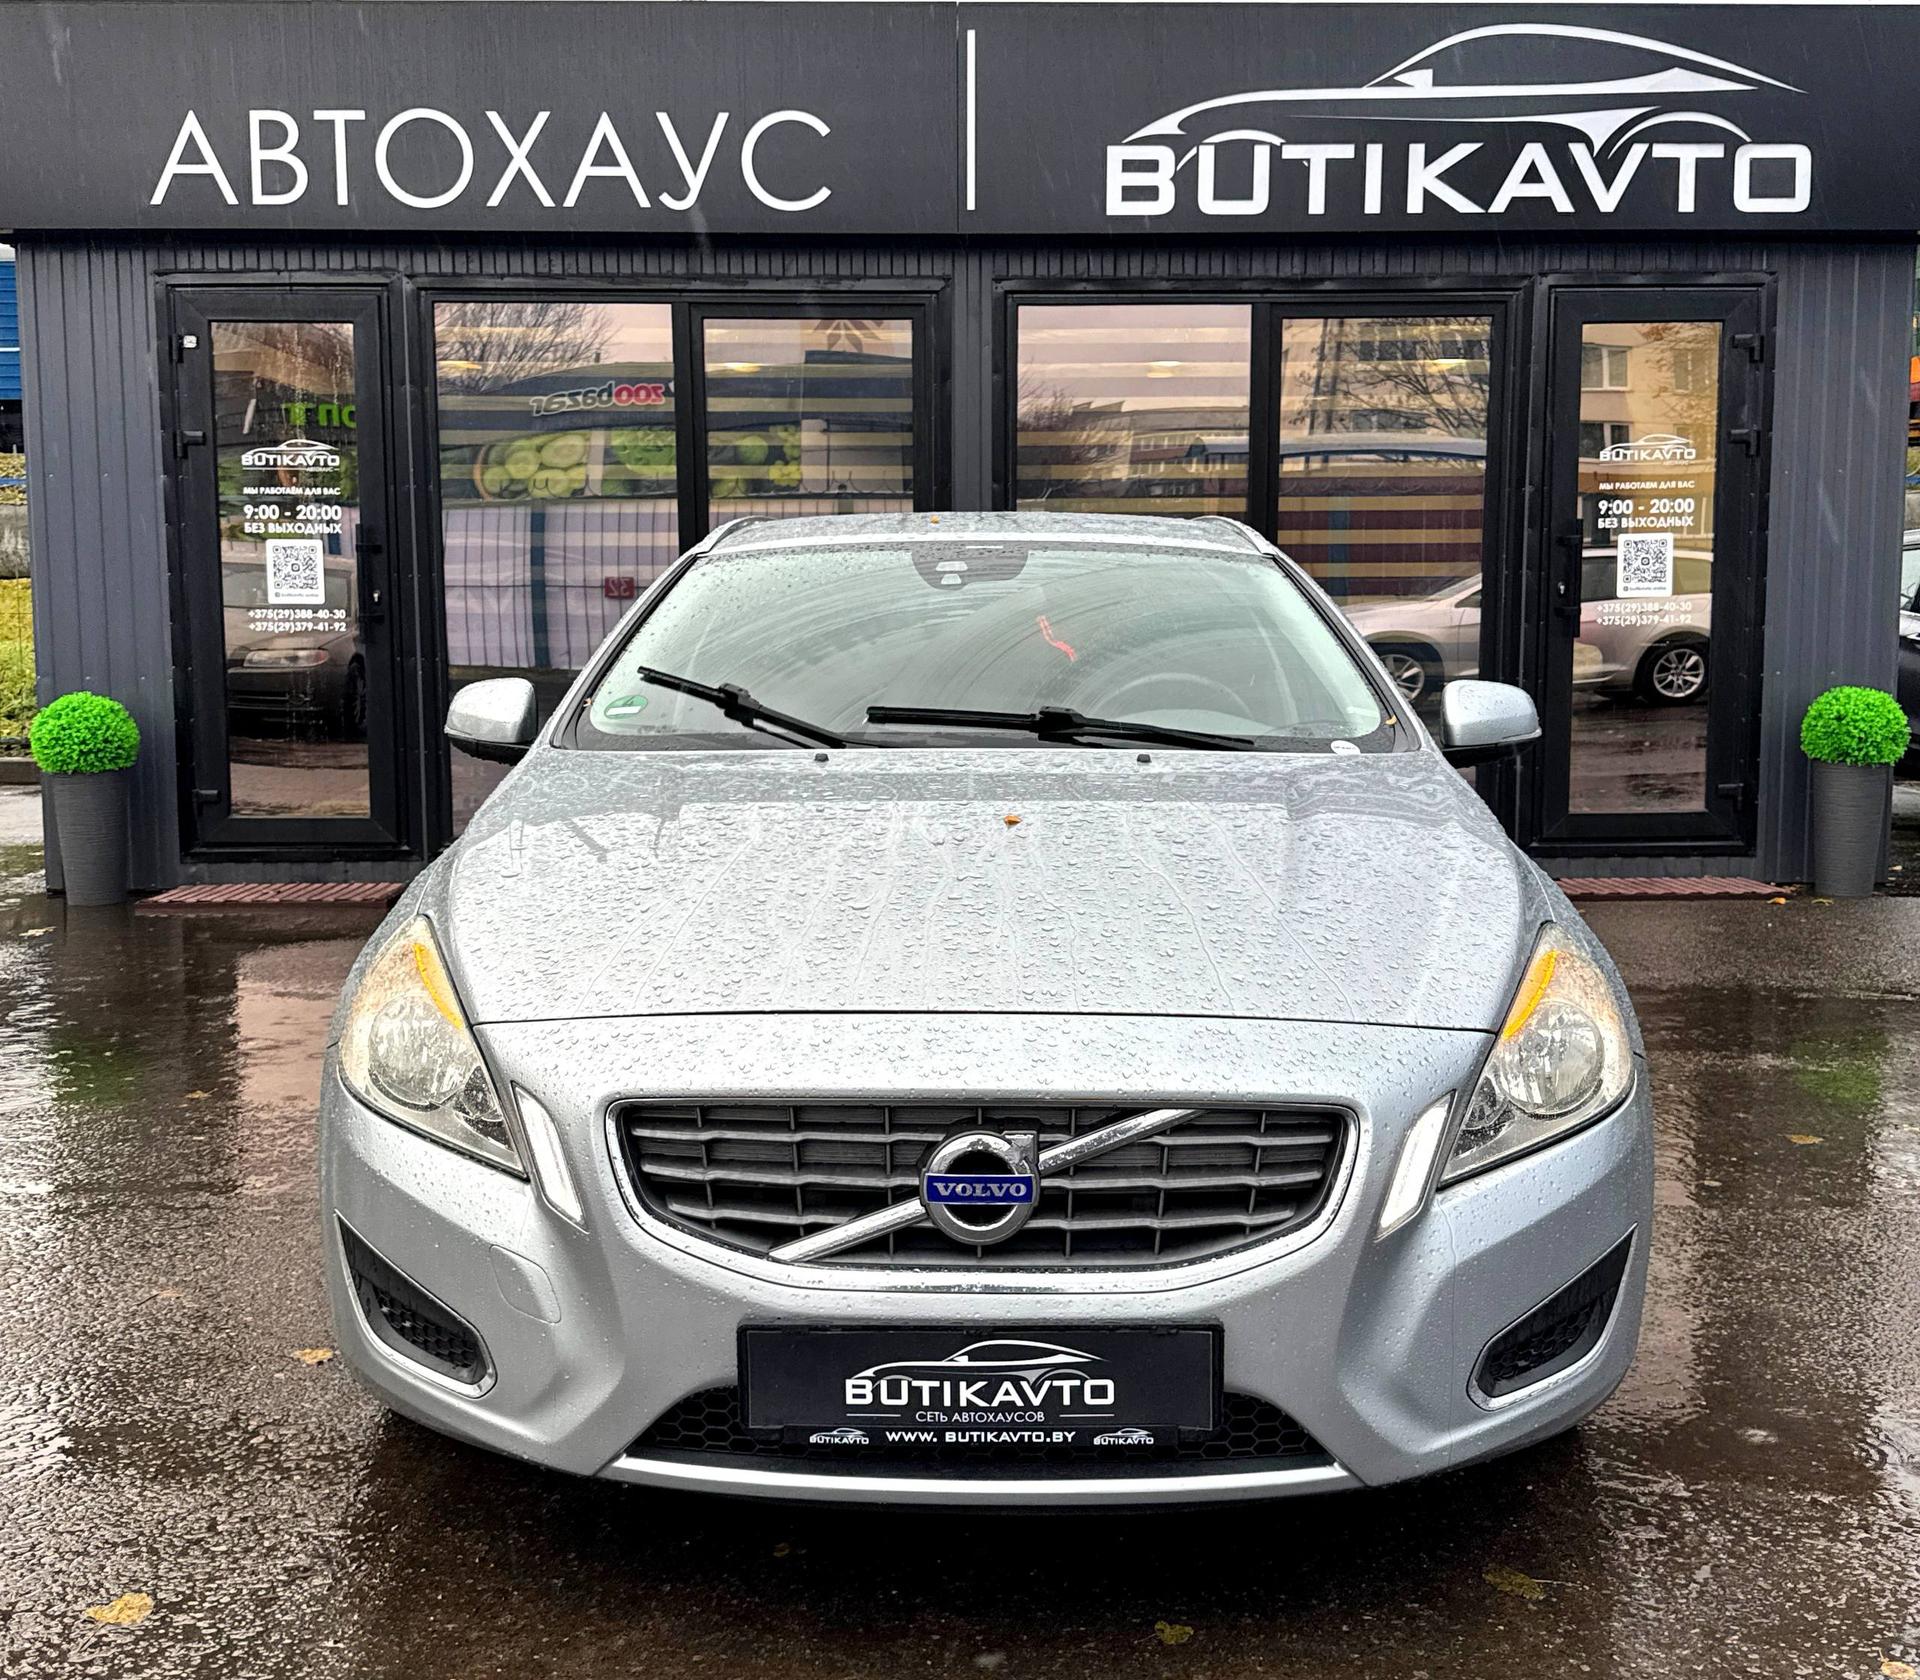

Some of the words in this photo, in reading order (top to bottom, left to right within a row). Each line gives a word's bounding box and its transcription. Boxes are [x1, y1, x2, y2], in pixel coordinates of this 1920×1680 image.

[150, 107, 832, 212] АВТОХАУС
[1105, 142, 1813, 217] BUTIKAVTO
[241, 454, 340, 467] BUTIKAVTO
[1599, 448, 1696, 462] BUTIKAVTO
[243, 486, 258, 495] МЫ
[304, 487, 321, 496] ДЛЯ
[323, 487, 341, 496] ВАС
[1599, 482, 1614, 491] МЫ
[1615, 481, 1658, 490] РАБОТАЕМ
[1659, 481, 1676, 490] ДЛЯ
[1677, 480, 1696, 489] ВАС
[243, 504, 280, 520] 9:00
[296, 505, 342, 521] 20:00
[1598, 499, 1634, 515] 9:00
[1649, 498, 1695, 514] 20:00
[244, 522, 266, 534] БЕЗ
[267, 522, 342, 536] ВЫХОДНЫХ
[1597, 517, 1618, 529] БЕЗ
[1621, 516, 1694, 529] ВЫХОДНЫХ
[248, 609, 346, 621] +375(29)388-40-30
[1596, 614, 1692, 627] +375(29)379-41-92
[248, 621, 347, 634] +375(29)379-41-92
[933, 1182, 1027, 1197] VOLVO
[845, 1378, 1115, 1408] BUTIKAVTO
[916, 1410, 947, 1424] СЕТЬ
[951, 1410, 1045, 1424] АВТОХАУСОВ
[809, 1436, 870, 1445] BUTIKAVTO
[885, 1430, 938, 1443] WWW.
[945, 1430, 1076, 1443] BUTIKAVTO.BY
[1093, 1436, 1154, 1446] BUTIKAVTO
